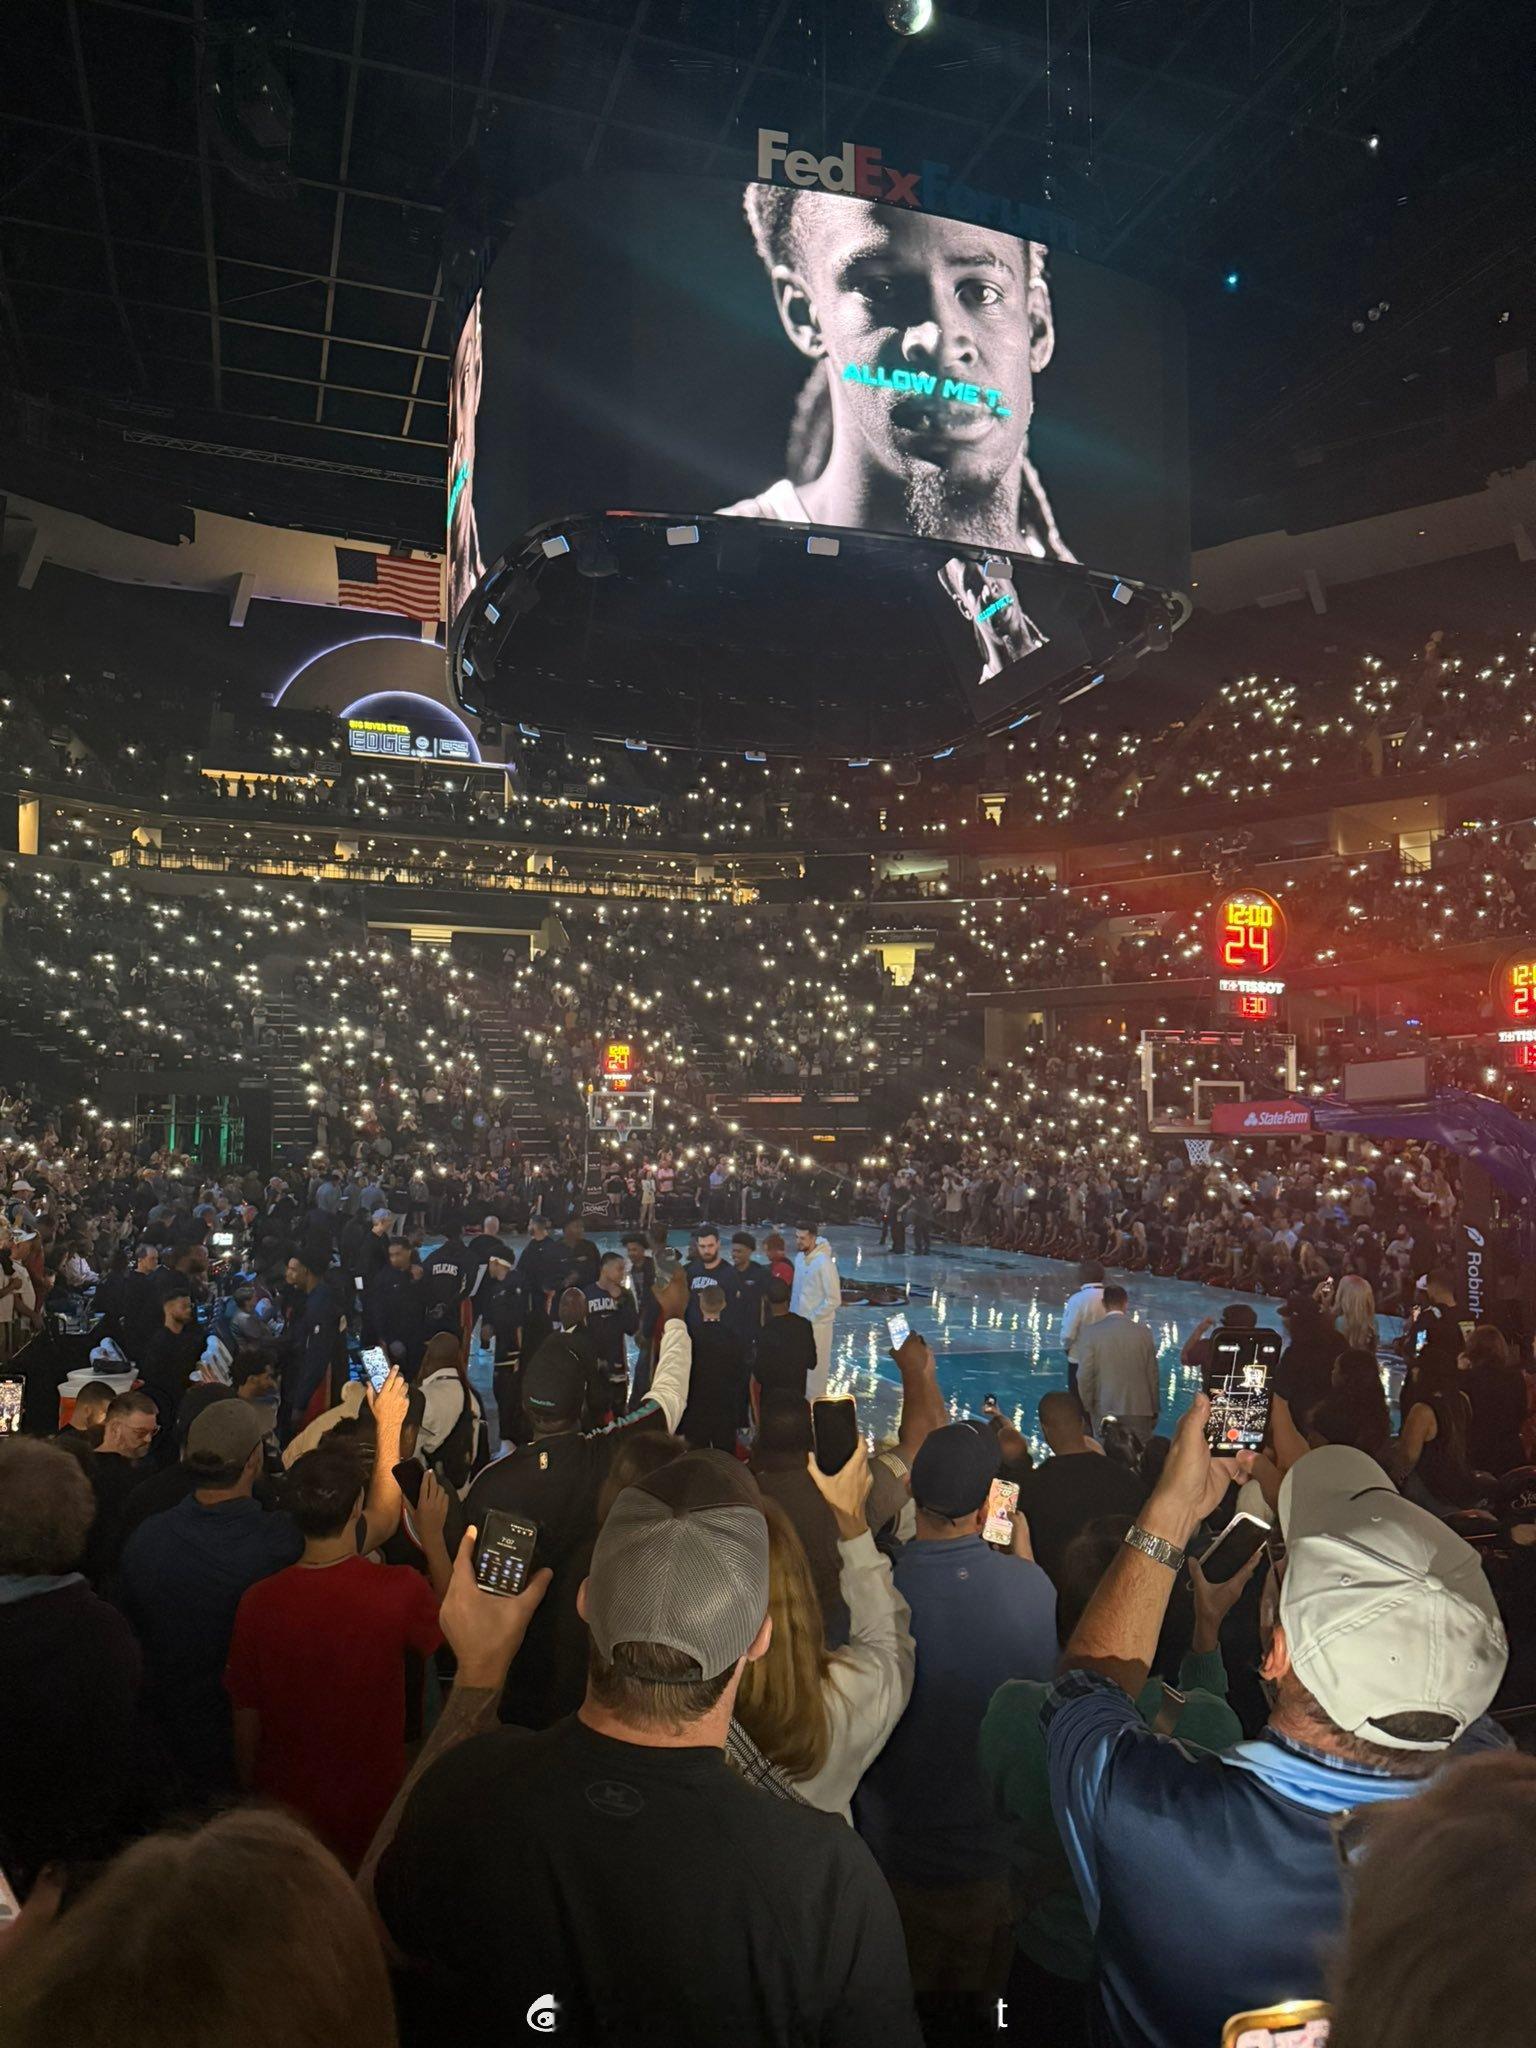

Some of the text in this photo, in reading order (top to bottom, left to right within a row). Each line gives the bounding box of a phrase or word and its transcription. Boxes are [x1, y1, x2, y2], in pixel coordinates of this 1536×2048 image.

[842, 362, 937, 397] ALLOW
[942, 378, 981, 406] ME
[364, 721, 387, 732] RIVER
[387, 723, 411, 734] STEEL
[349, 731, 411, 756] EDGE
[1228, 903, 1273, 927] 12:00
[1225, 926, 1269, 966] 24
[1238, 980, 1285, 994] TISSOT
[1242, 997, 1267, 1013] 1:30
